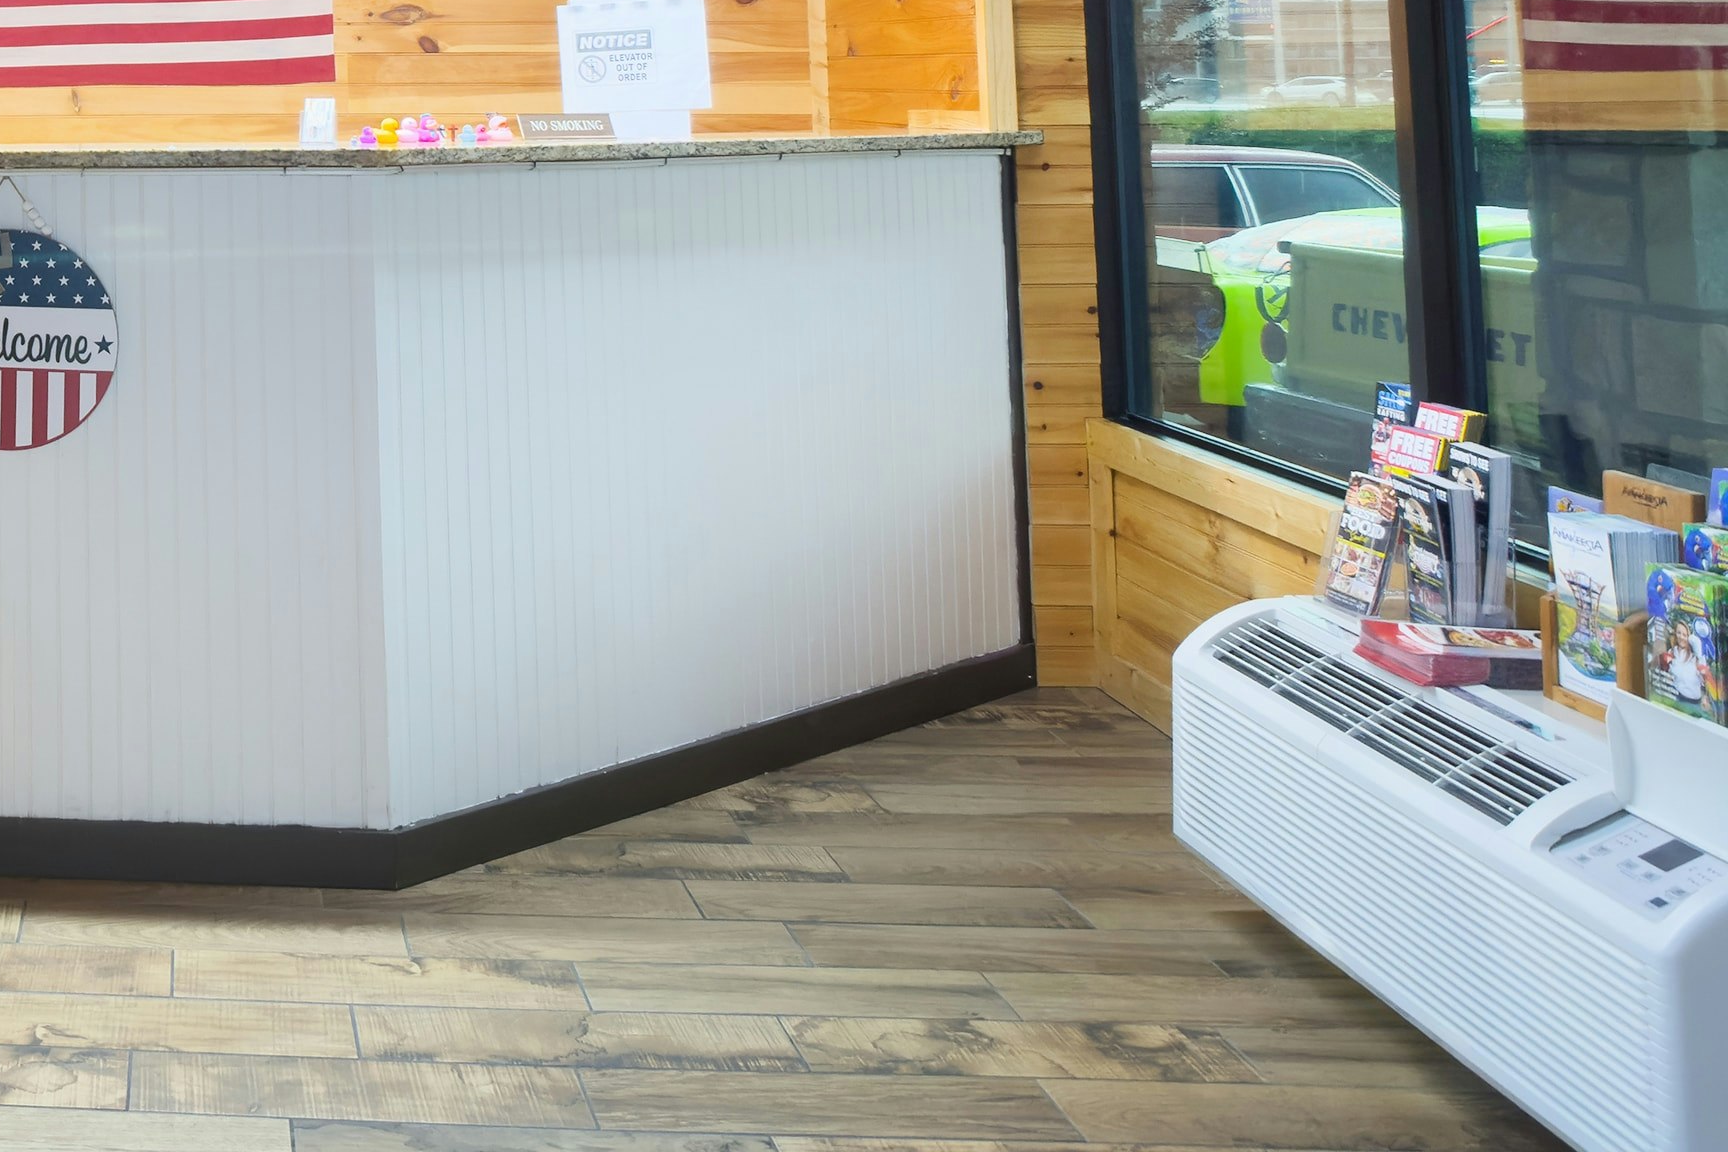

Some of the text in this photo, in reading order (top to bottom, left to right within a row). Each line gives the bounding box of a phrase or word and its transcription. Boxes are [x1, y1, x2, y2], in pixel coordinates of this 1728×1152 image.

[578, 33, 649, 50] NOTICE
[609, 52, 653, 62] ELEVATOR
[616, 63, 648, 72] OUT OF
[618, 73, 648, 82] ORDER
[529, 119, 604, 132] NO SMOKING
[1414, 407, 1459, 439] FREE
[1390, 429, 1435, 461] FREE
[1388, 451, 1431, 474] COUPONS
[1340, 512, 1386, 540] FOOD
